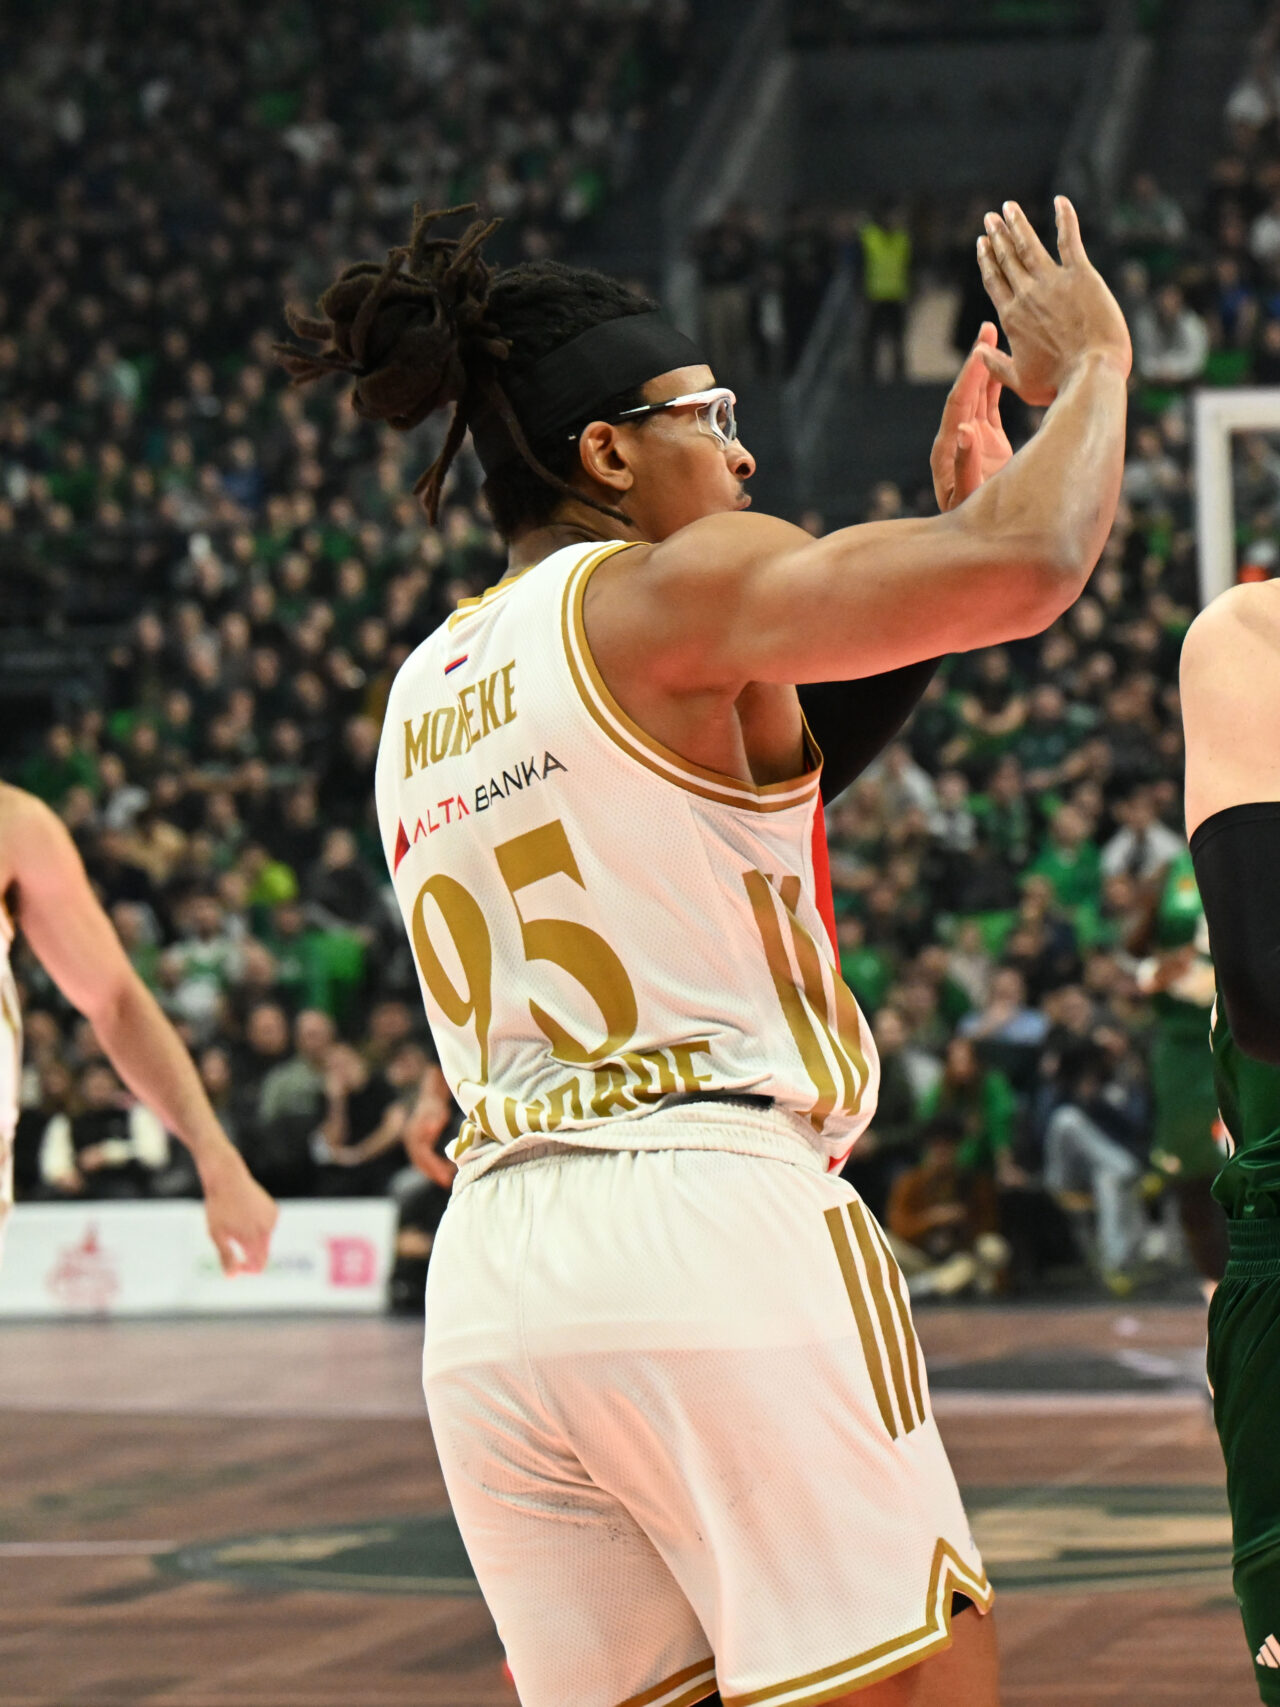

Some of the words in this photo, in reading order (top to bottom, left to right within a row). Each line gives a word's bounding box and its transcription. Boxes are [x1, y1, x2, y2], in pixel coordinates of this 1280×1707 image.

[413, 794, 471, 844] ALTA
[475, 750, 569, 813] BANKA
[412, 818, 639, 1086] 95
